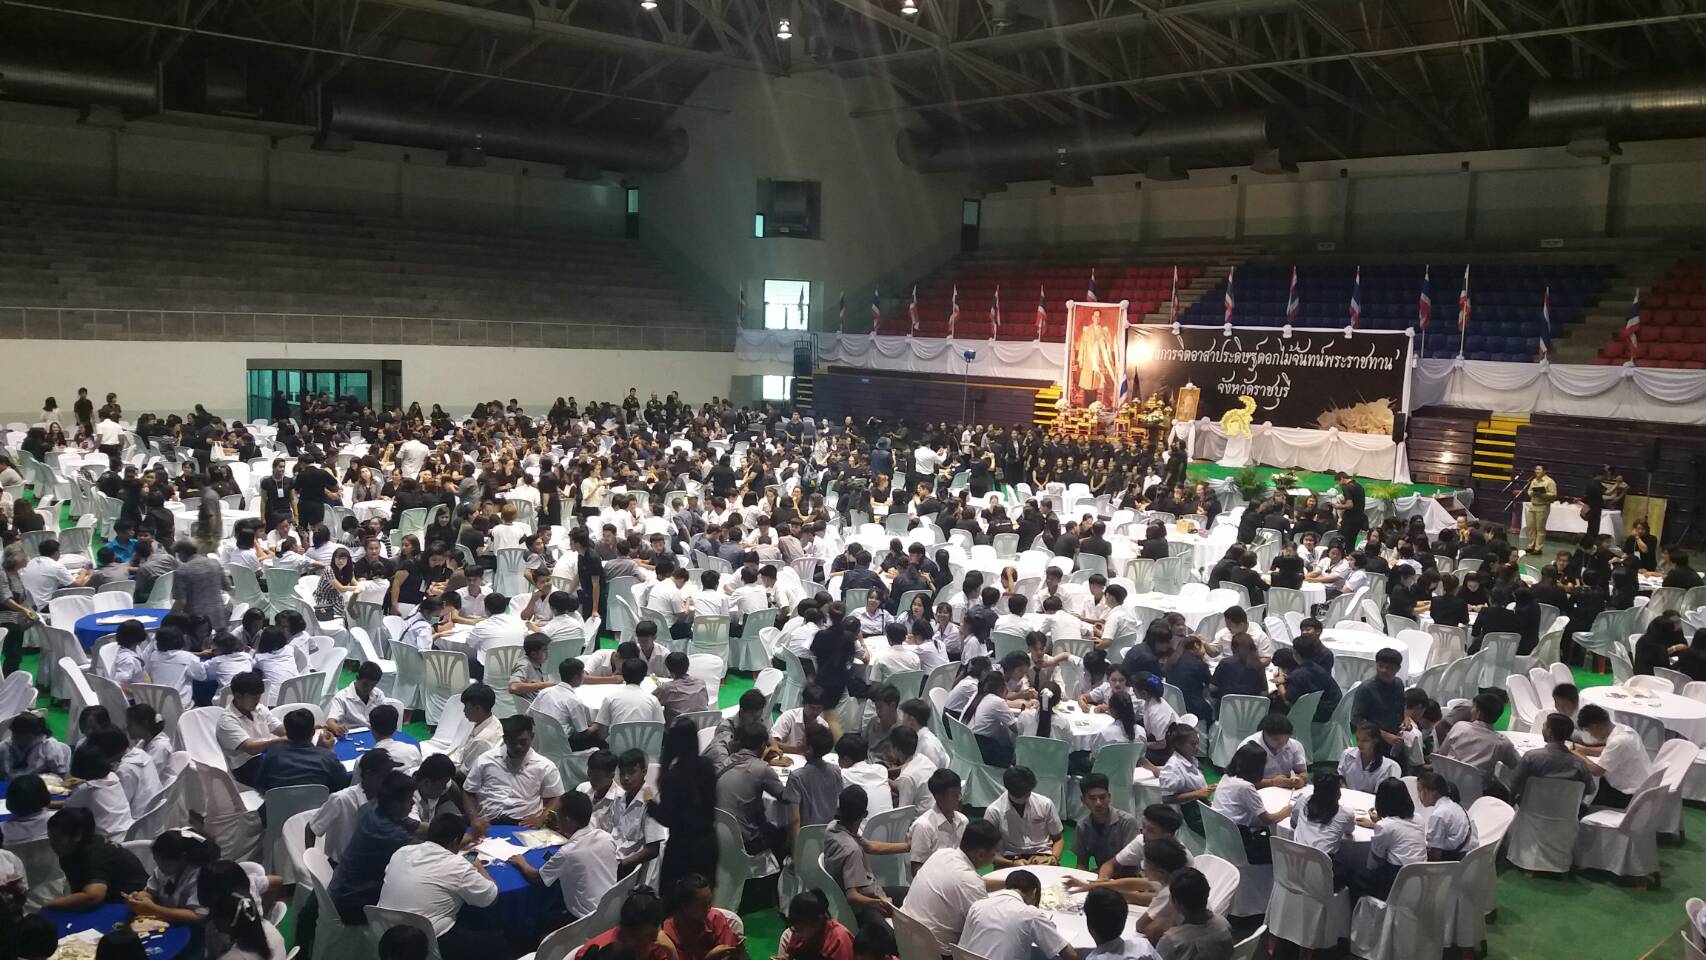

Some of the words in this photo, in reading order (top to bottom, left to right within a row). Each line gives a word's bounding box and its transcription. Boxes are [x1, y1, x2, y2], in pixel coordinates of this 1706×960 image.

[1217, 370, 1291, 410] จังหวัดราชบุรี
